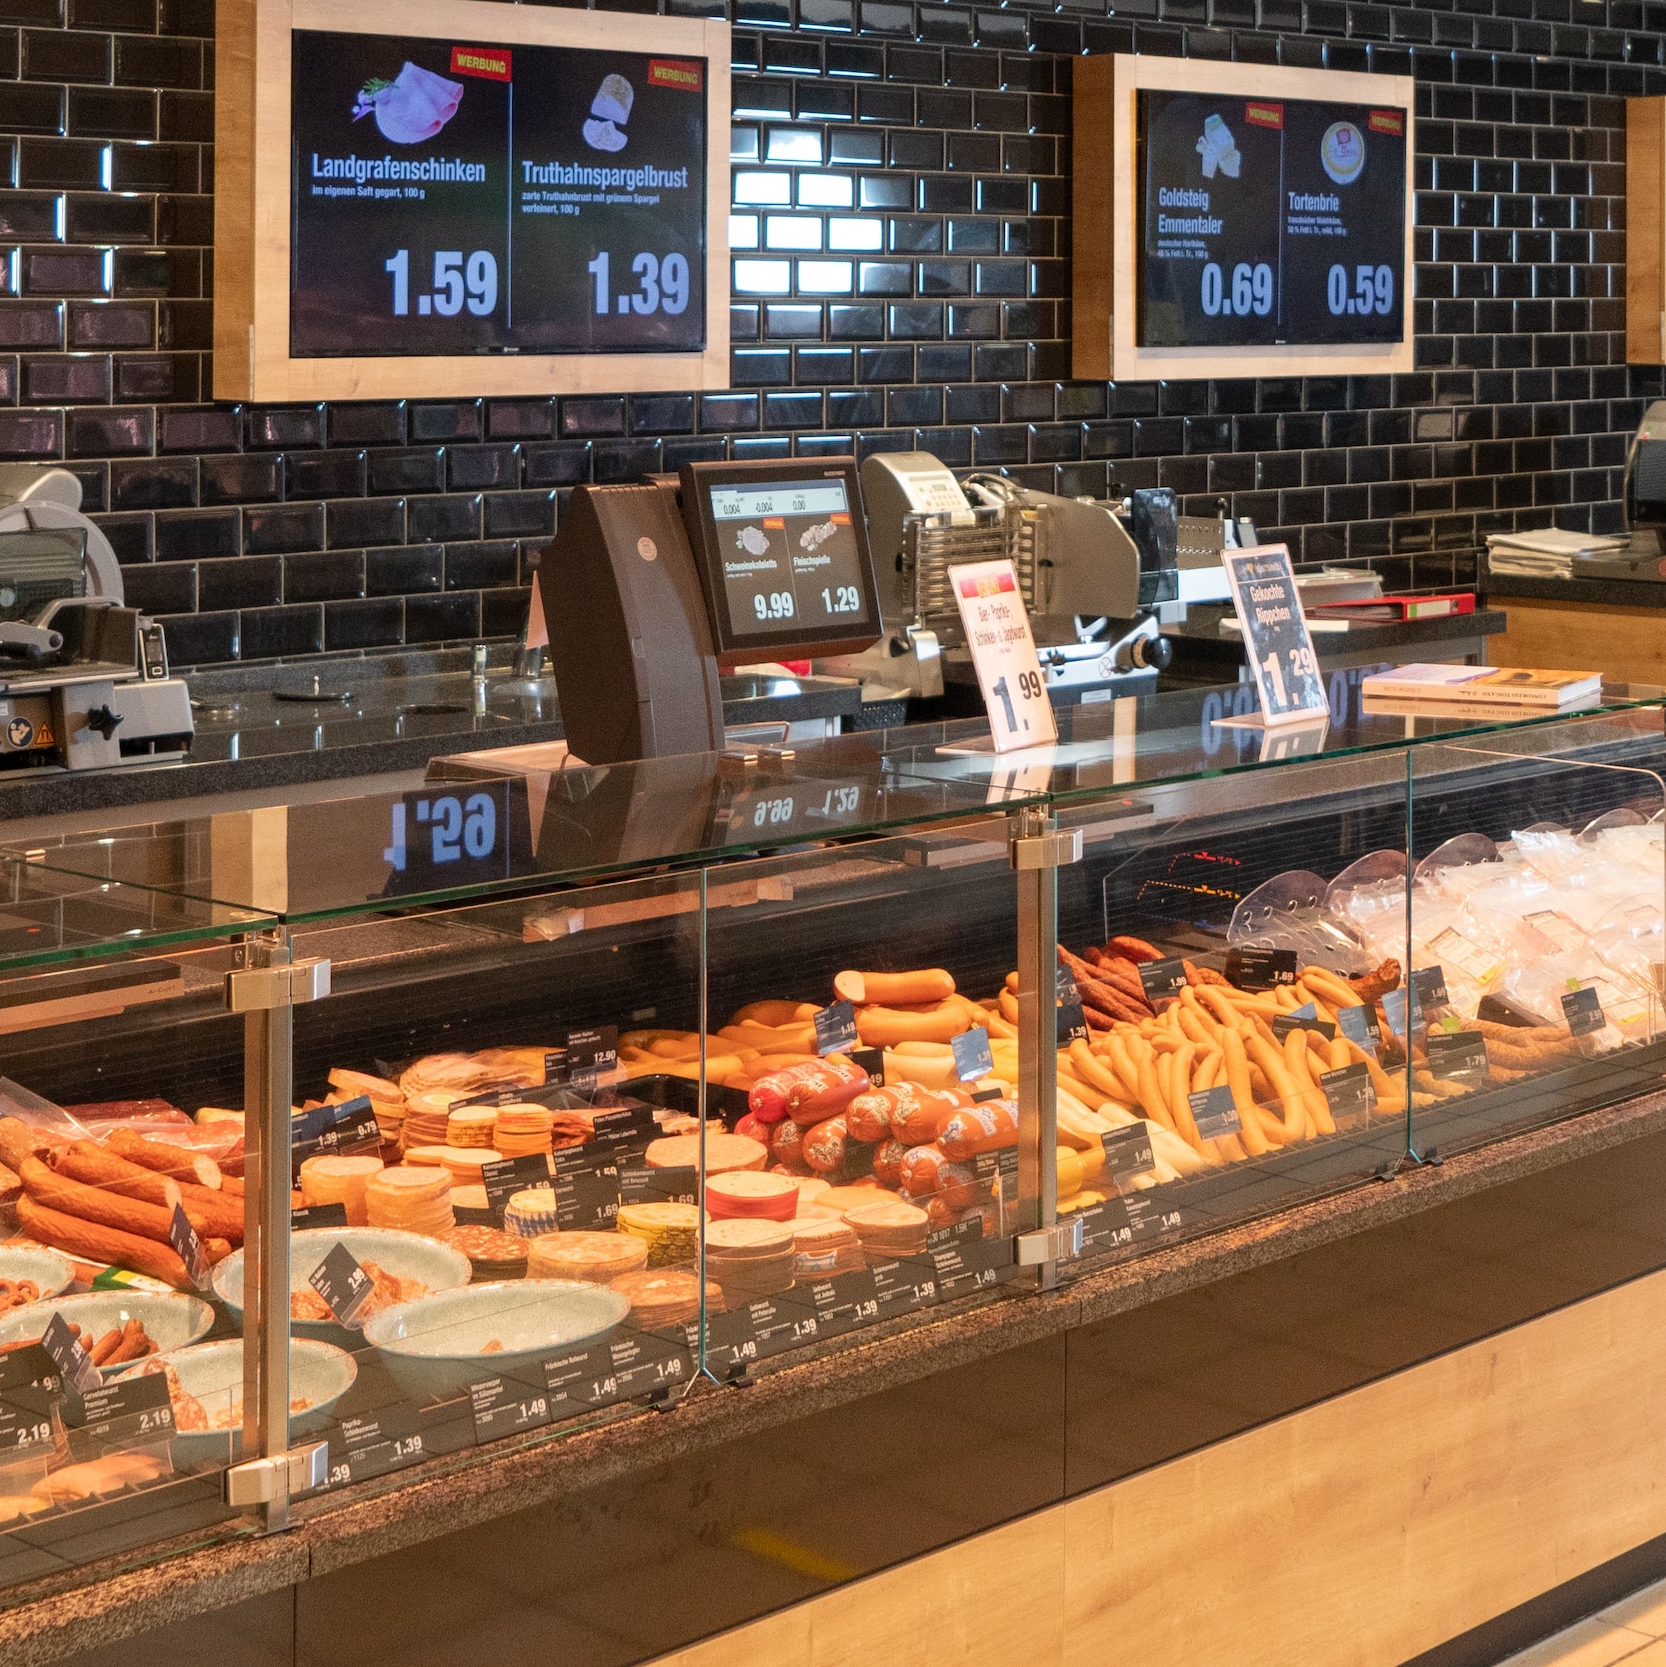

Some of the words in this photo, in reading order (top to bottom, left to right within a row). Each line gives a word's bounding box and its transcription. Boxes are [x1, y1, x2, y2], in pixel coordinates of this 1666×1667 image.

[456, 53, 506, 74] WERBUNG
[654, 66, 698, 85] WERBUNG
[312, 153, 486, 183] Landgrafenschinken
[522, 160, 687, 190] Truthahnspargelbrust
[312, 186, 323, 195] im
[324, 187, 355, 197] eigenen
[357, 186, 373, 197] Saft
[375, 188, 402, 199] gegart,
[404, 188, 417, 198] 100
[419, 190, 425, 199] g
[522, 192, 540, 201] zarte
[542, 191, 592, 202] Truthahnbrust
[593, 193, 604, 202] mit
[606, 193, 632, 203] grünem
[634, 193, 660, 205] Spargel
[1158, 186, 1209, 212] Goldsteig
[1288, 191, 1340, 211] Tortenbrie
[522, 203, 558, 214] verfeinert,
[560, 204, 573, 213] 100
[575, 207, 580, 215] g
[1158, 214, 1223, 234] Emmentaler
[385, 249, 498, 316] 1.59
[587, 251, 689, 314] 1.39
[1201, 262, 1273, 316] 0.69
[1327, 264, 1393, 315] 0.59
[821, 586, 860, 613] 1.29
[1250, 585, 1285, 602] Gekochte
[754, 591, 794, 620] 9.99
[1256, 607, 1291, 627] Rippchen
[1170, 976, 1187, 988] 1.99
[1273, 971, 1294, 981] 1.69
[1069, 1027, 1087, 1037] 1.39
[594, 1050, 616, 1063] 12.90
[1464, 1055, 1486, 1067] 1.79
[357, 1119, 378, 1137] 0.79
[1134, 1148, 1152, 1163] 1.49
[596, 1202, 619, 1220] 1.69
[1161, 1211, 1181, 1227] 1.49
[1112, 1228, 1132, 1243] 1.49
[348, 1267, 366, 1290] 2.99
[974, 1268, 996, 1286] 1.49
[913, 1281, 935, 1299] 1.39
[855, 1299, 878, 1319] 1.39
[793, 1318, 817, 1337] 1.39
[732, 1340, 757, 1360] 1.49
[657, 1358, 681, 1378] 1.49
[592, 1377, 618, 1397] 1.49
[519, 1398, 547, 1419] 1.49
[140, 1409, 171, 1431] 2.19
[17, 1422, 51, 1445] 2.19
[394, 1436, 423, 1458] 1.39
